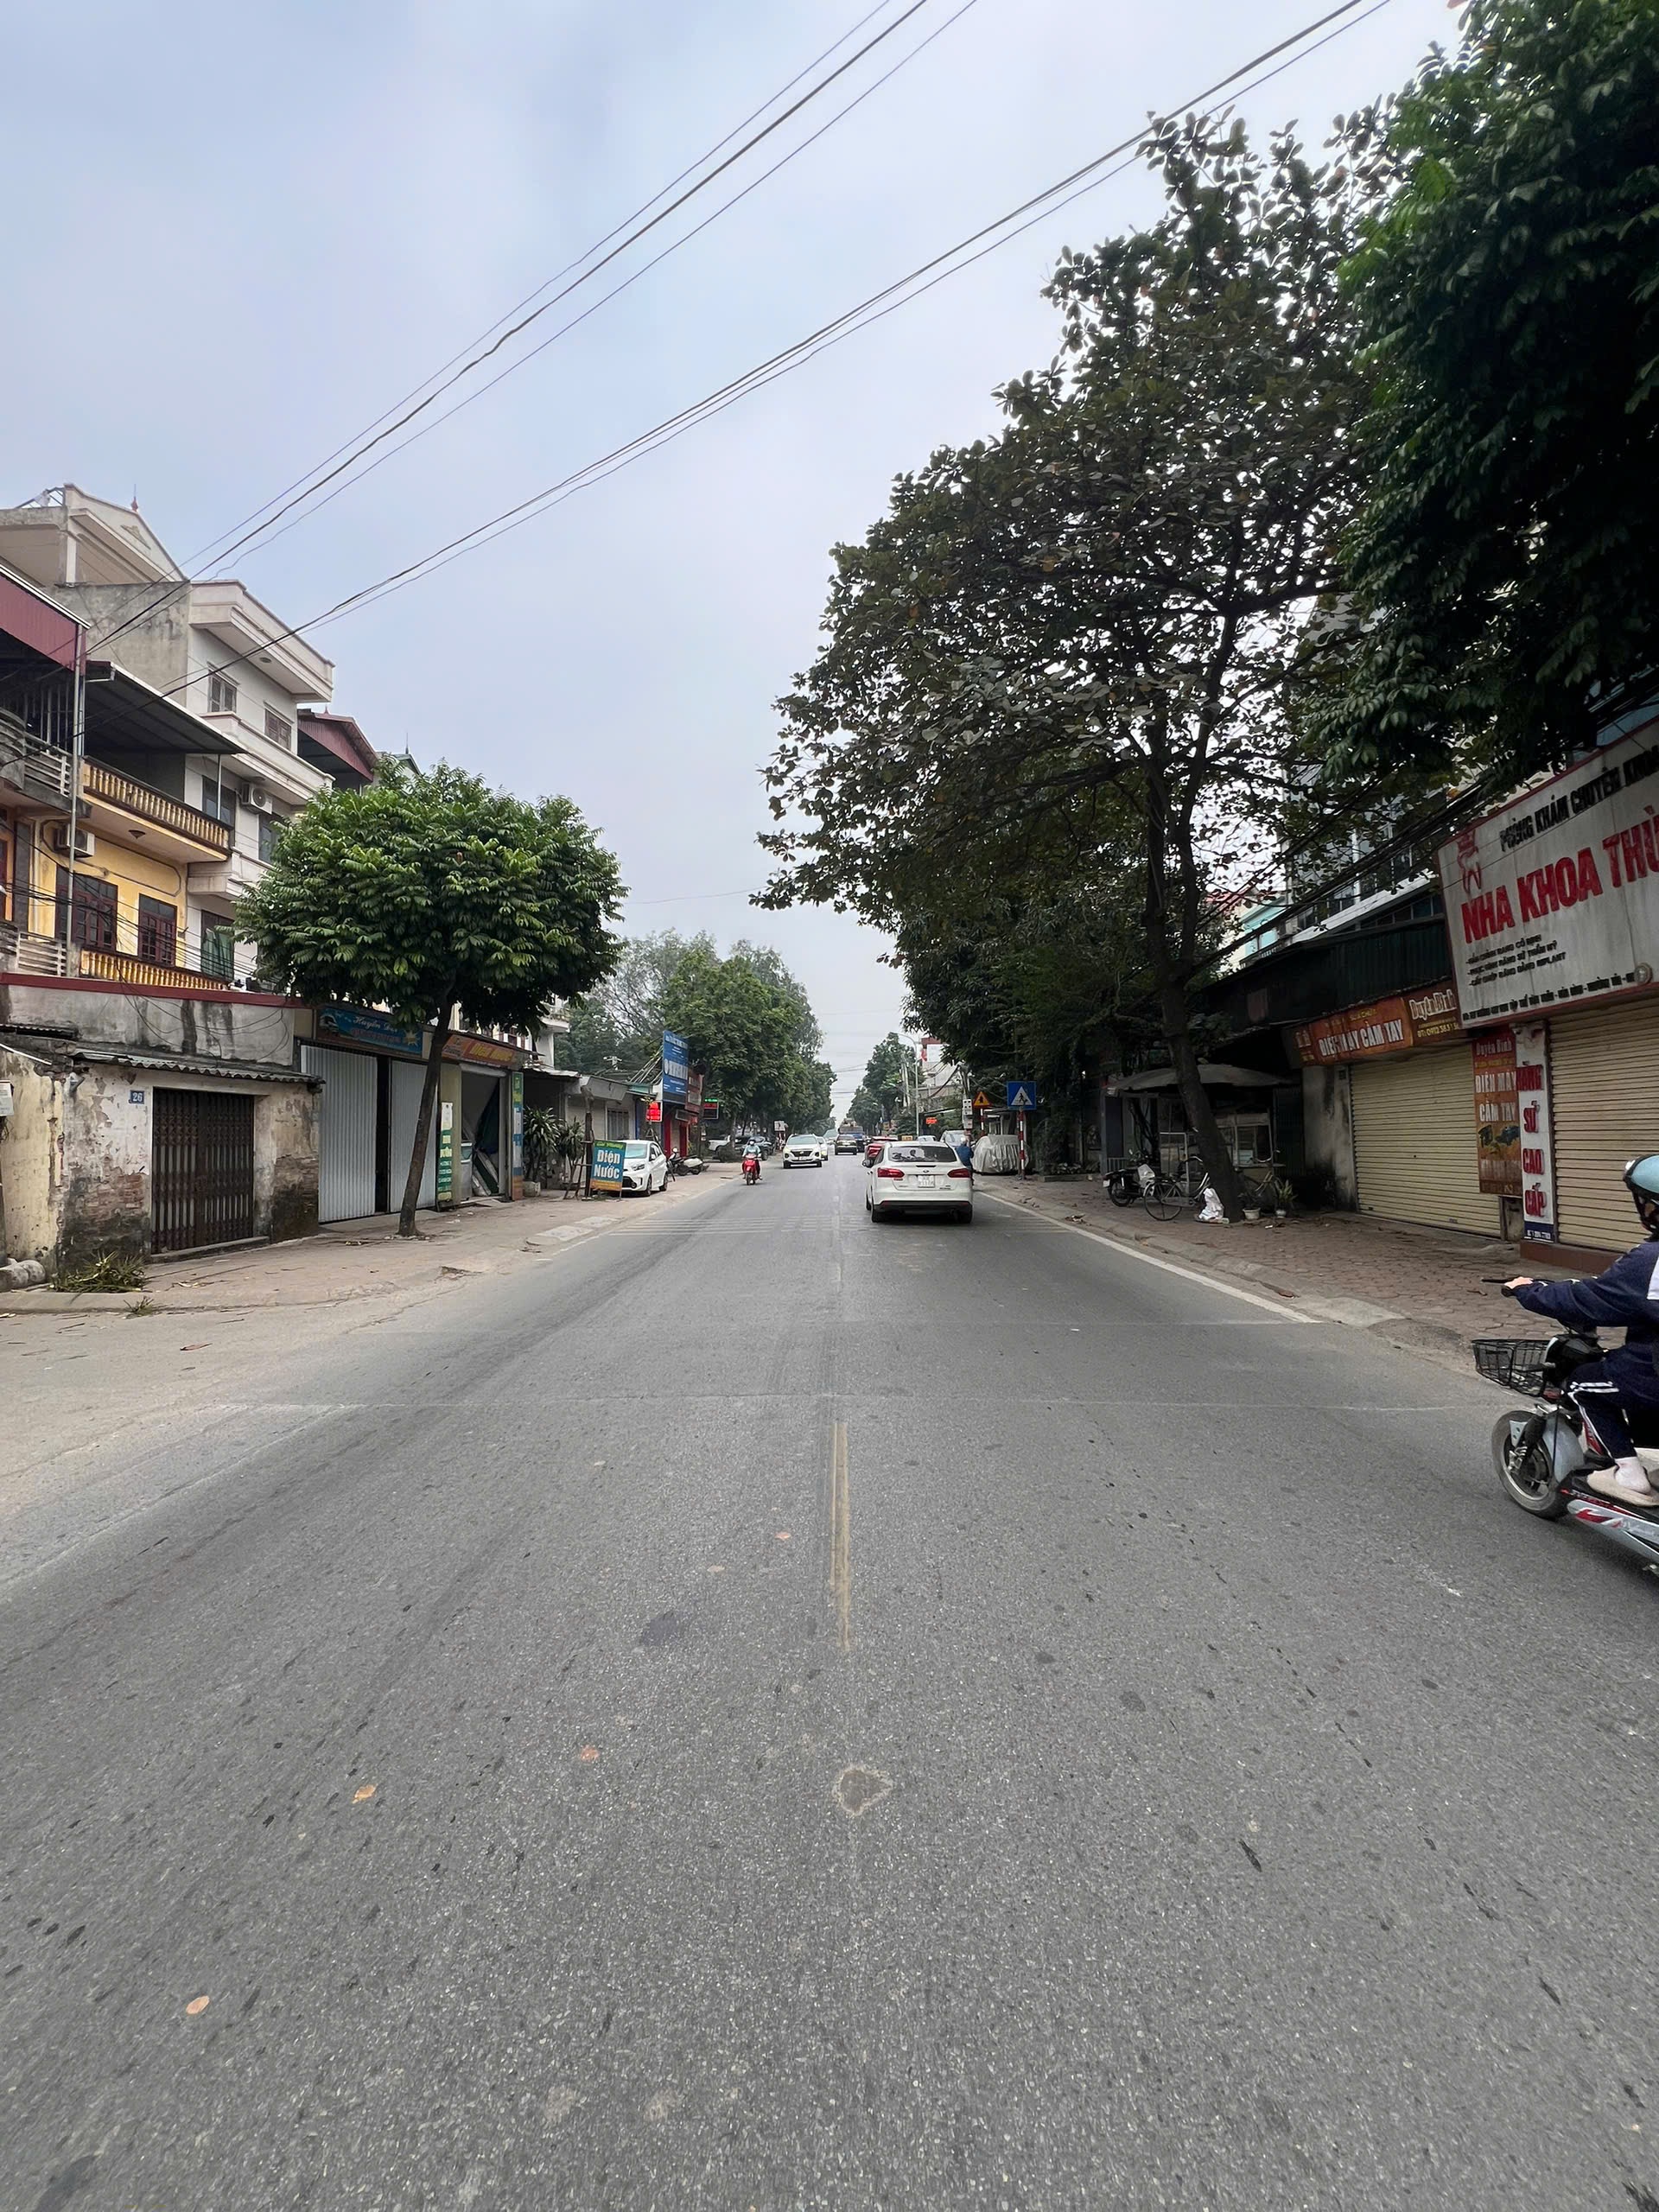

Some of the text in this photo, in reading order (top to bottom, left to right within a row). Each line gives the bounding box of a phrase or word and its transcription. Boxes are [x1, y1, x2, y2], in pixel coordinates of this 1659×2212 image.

[1534, 794, 1570, 834] KHÁM
[1570, 766, 1622, 814] CHUYÊN
[1461, 885, 1516, 944] NHA
[1516, 847, 1603, 923] KHOA
[1408, 996, 1434, 1020] Duyên
[1383, 1019, 1404, 1043] TAY
[132, 1091, 143, 1103] 26
[1523, 1100, 1541, 1134] SỨ
[596, 1148, 621, 1166] Điện
[1522, 1147, 1545, 1175] CAO
[594, 1164, 620, 1179] Nước
